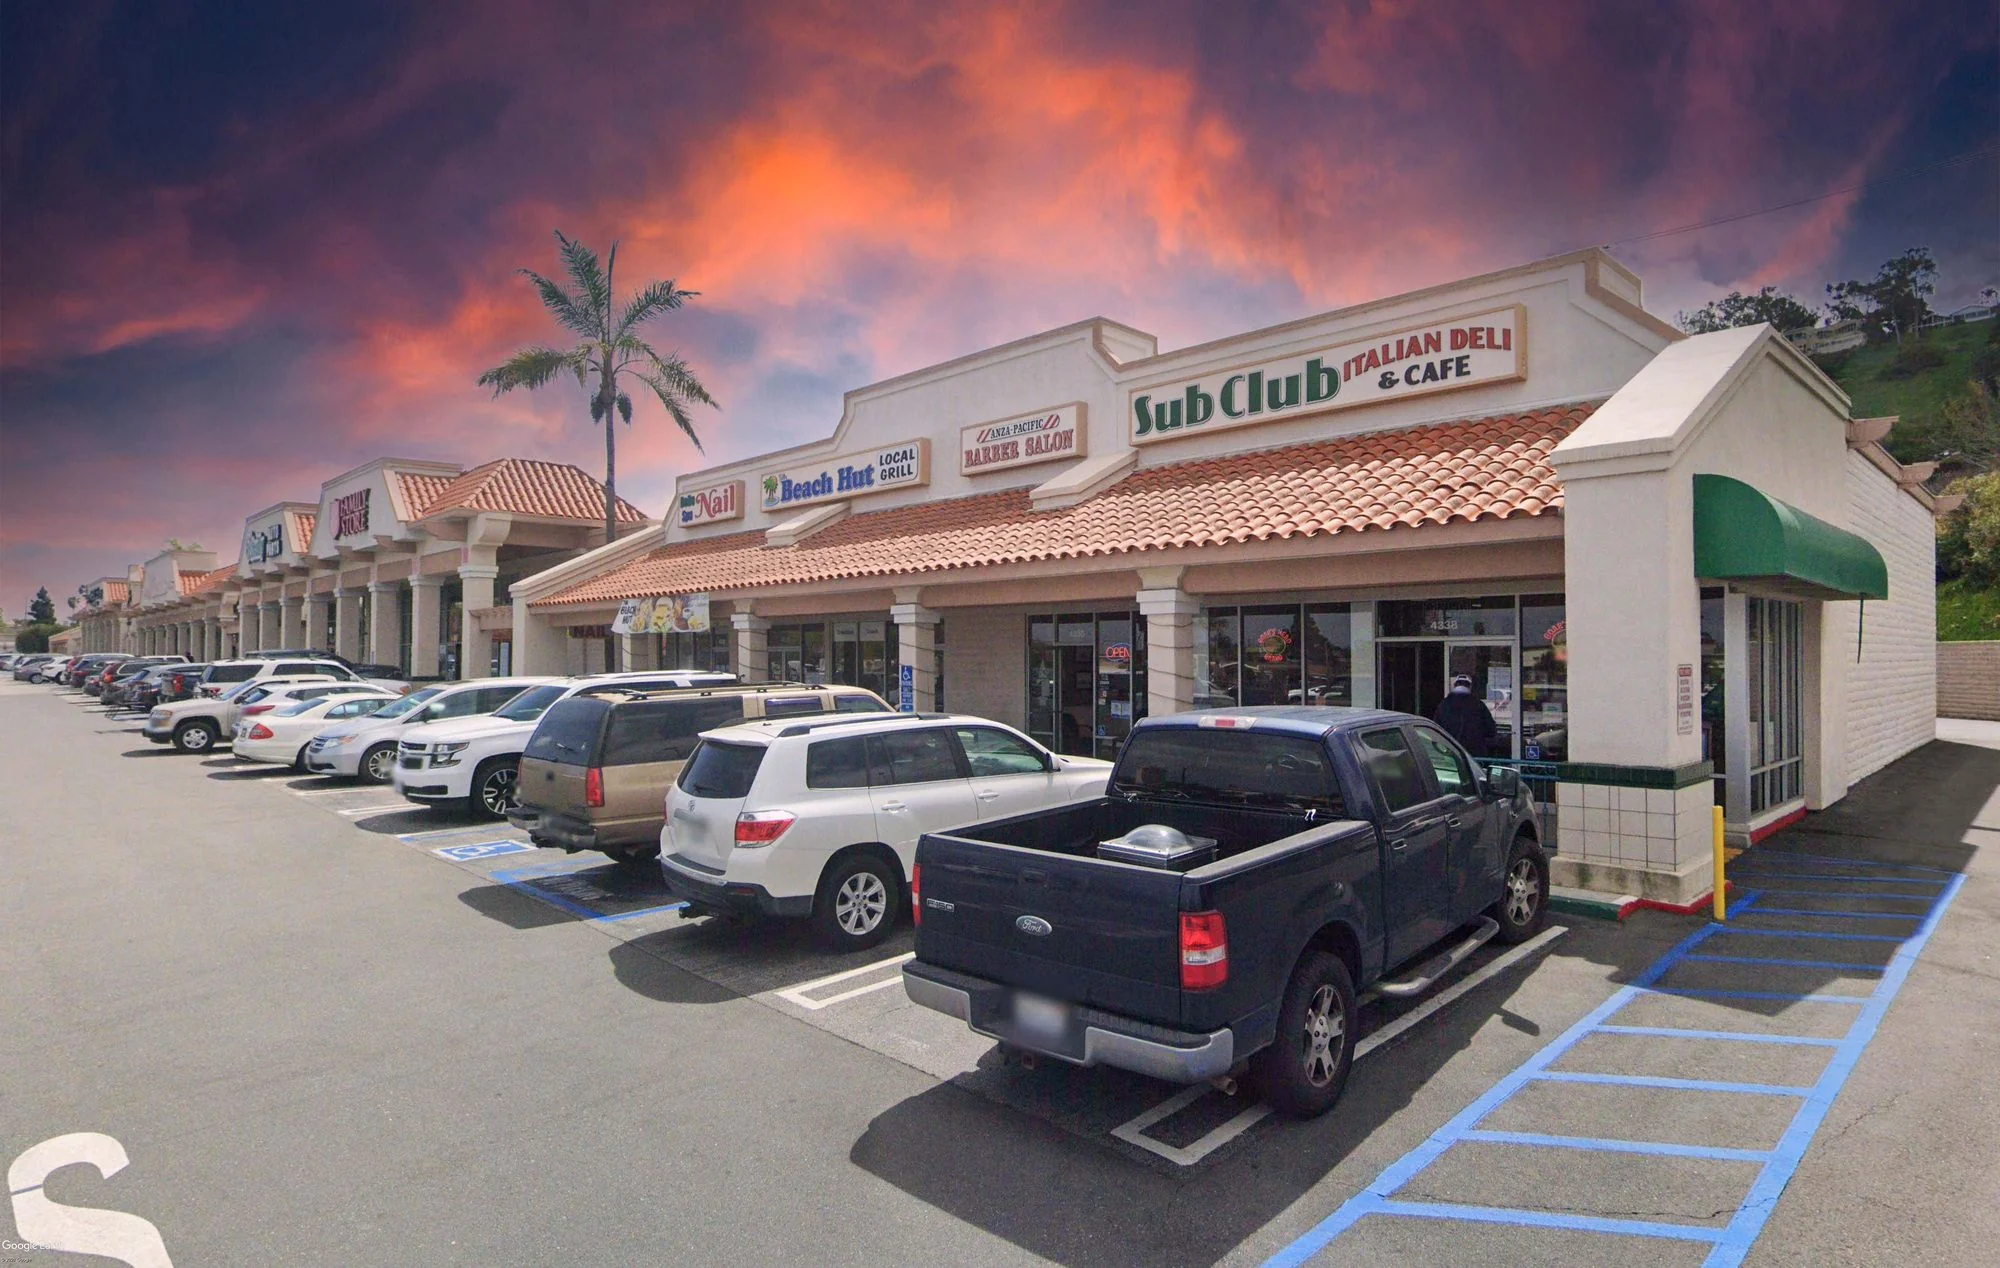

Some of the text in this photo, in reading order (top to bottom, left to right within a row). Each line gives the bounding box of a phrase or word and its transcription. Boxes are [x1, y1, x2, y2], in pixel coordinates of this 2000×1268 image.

[1343, 327, 1512, 382] ITALIAN DELI
[1378, 355, 1471, 389] & CAFE
[990, 418, 1044, 439] ANZA-PACIFIC
[879, 448, 915, 467] LOCAL
[964, 428, 1074, 469] BARBER SALON
[780, 463, 875, 502] Beach Hut
[880, 463, 913, 481] GRILL
[340, 488, 371, 518] FAMILY
[695, 484, 735, 519] Nail
[340, 510, 369, 537] STORE
[1105, 646, 1130, 658] OPEN
[1022, 919, 1042, 933] Ford
